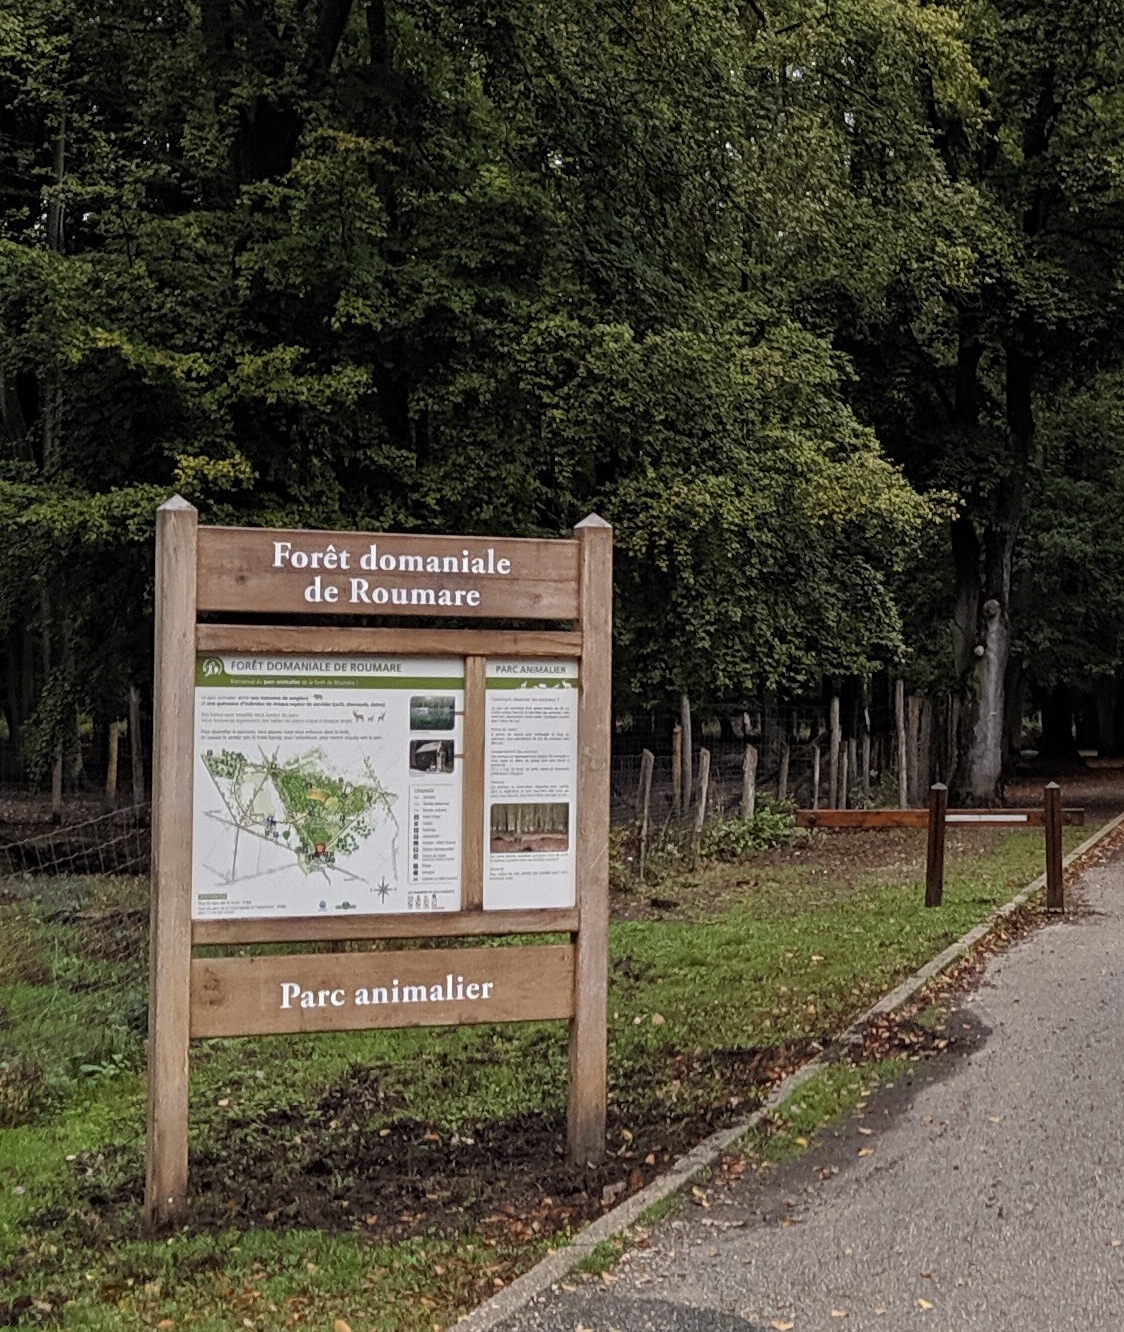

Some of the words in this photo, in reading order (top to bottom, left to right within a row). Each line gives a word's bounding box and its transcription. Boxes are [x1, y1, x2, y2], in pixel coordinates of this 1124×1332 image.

[271, 540, 350, 569] Forêt
[359, 543, 511, 574] domaniale
[304, 575, 339, 603] de
[348, 577, 481, 606] Roumare
[230, 659, 263, 671] FORÊT
[266, 661, 331, 672] DOMANIALE
[334, 661, 348, 672] DE
[350, 662, 402, 673] ROUMARE
[495, 665, 518, 674] PARC
[520, 666, 567, 674] ANIMALIER
[279, 982, 346, 1009] Parc
[354, 973, 494, 1005] animalier
